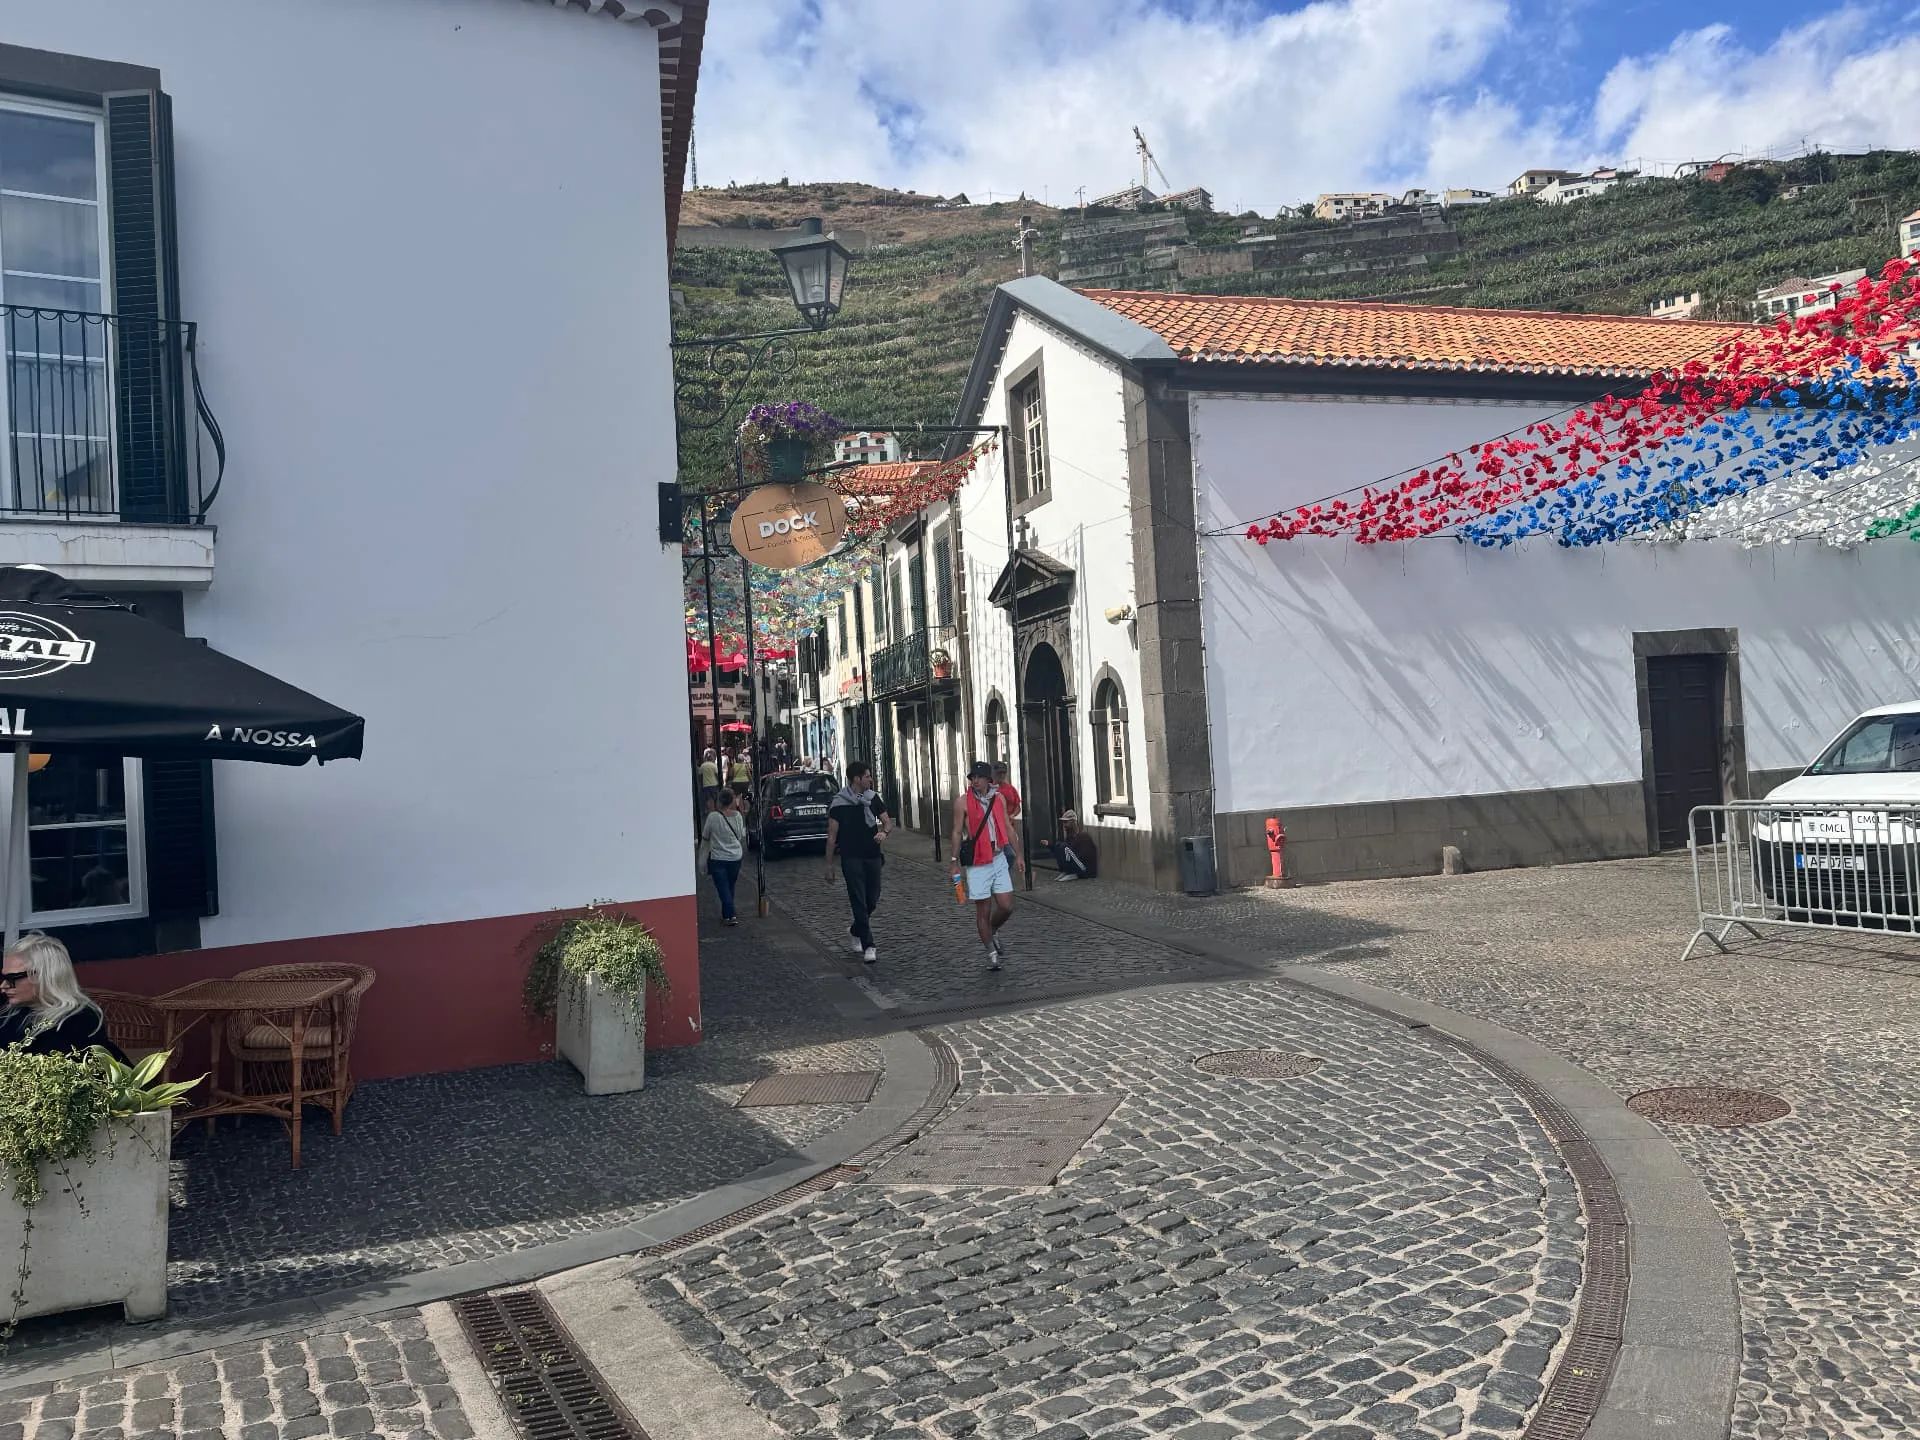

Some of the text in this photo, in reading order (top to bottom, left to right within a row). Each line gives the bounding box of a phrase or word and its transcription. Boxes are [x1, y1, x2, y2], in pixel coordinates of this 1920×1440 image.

[759, 511, 820, 538] DOCK
[232, 728, 316, 747] NOSSA
[1820, 823, 1846, 833] CMCL
